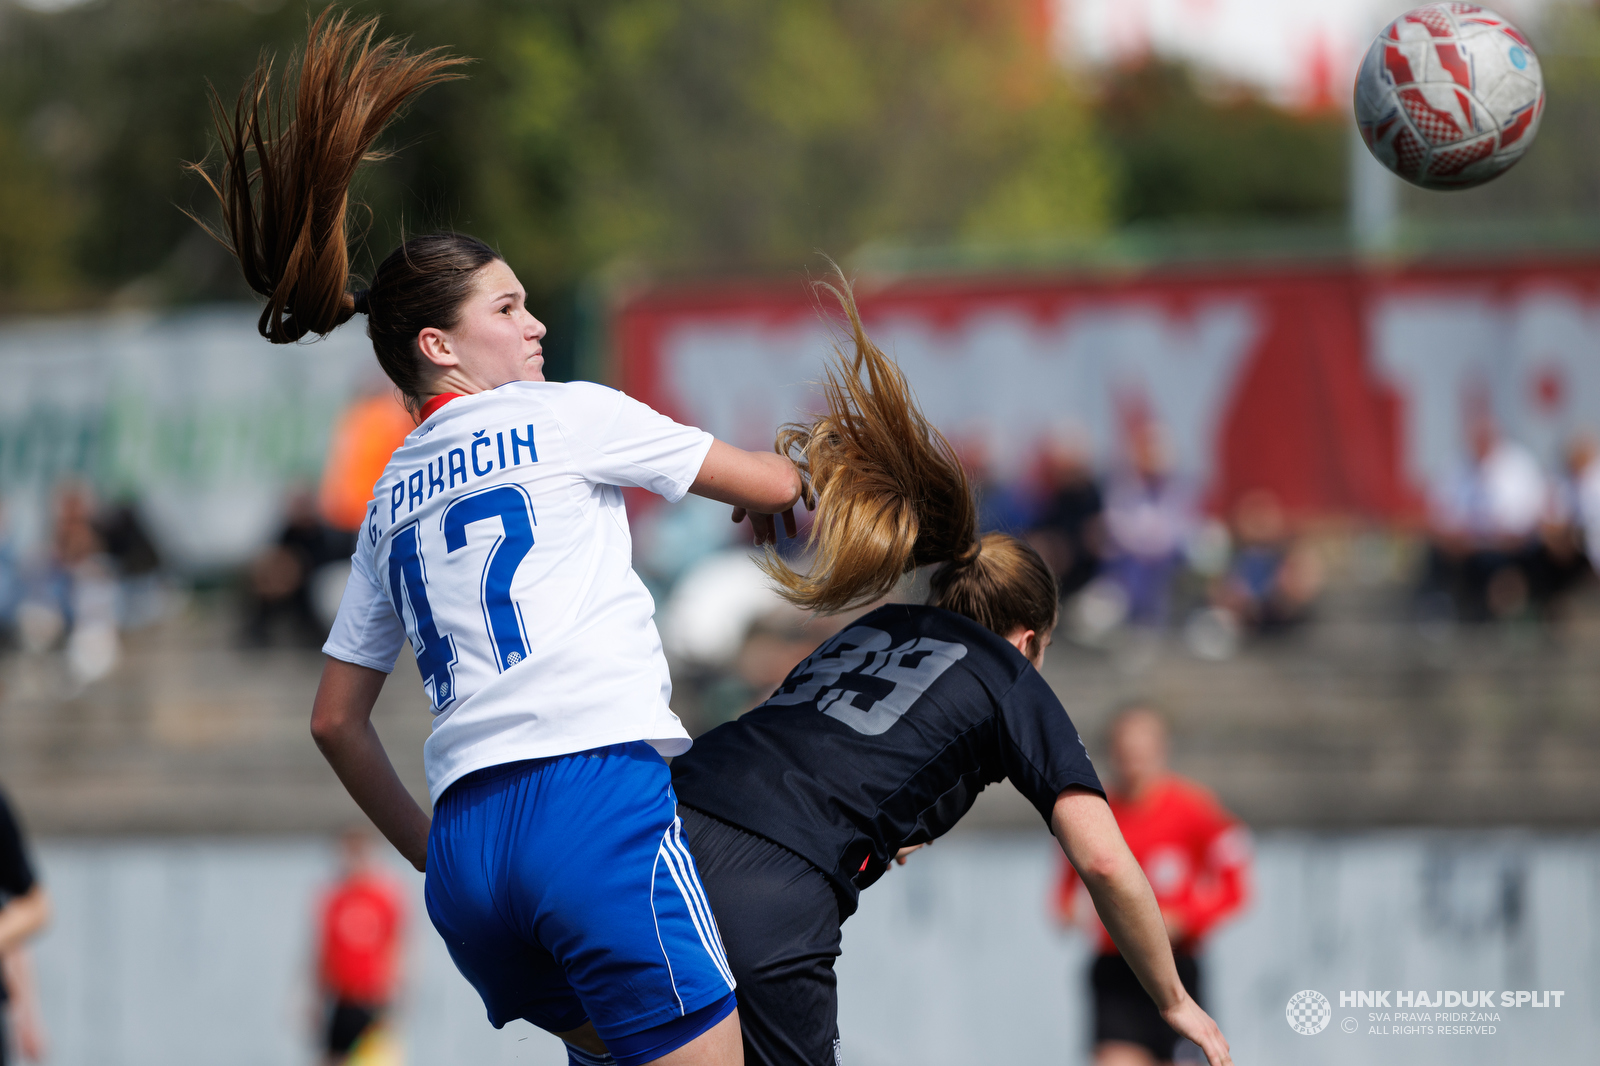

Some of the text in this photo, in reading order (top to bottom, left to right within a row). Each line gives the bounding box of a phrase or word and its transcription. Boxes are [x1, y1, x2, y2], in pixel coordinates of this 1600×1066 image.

[367, 504, 382, 548] G.
[390, 423, 539, 525] PRKAČIN
[388, 482, 538, 712] 47
